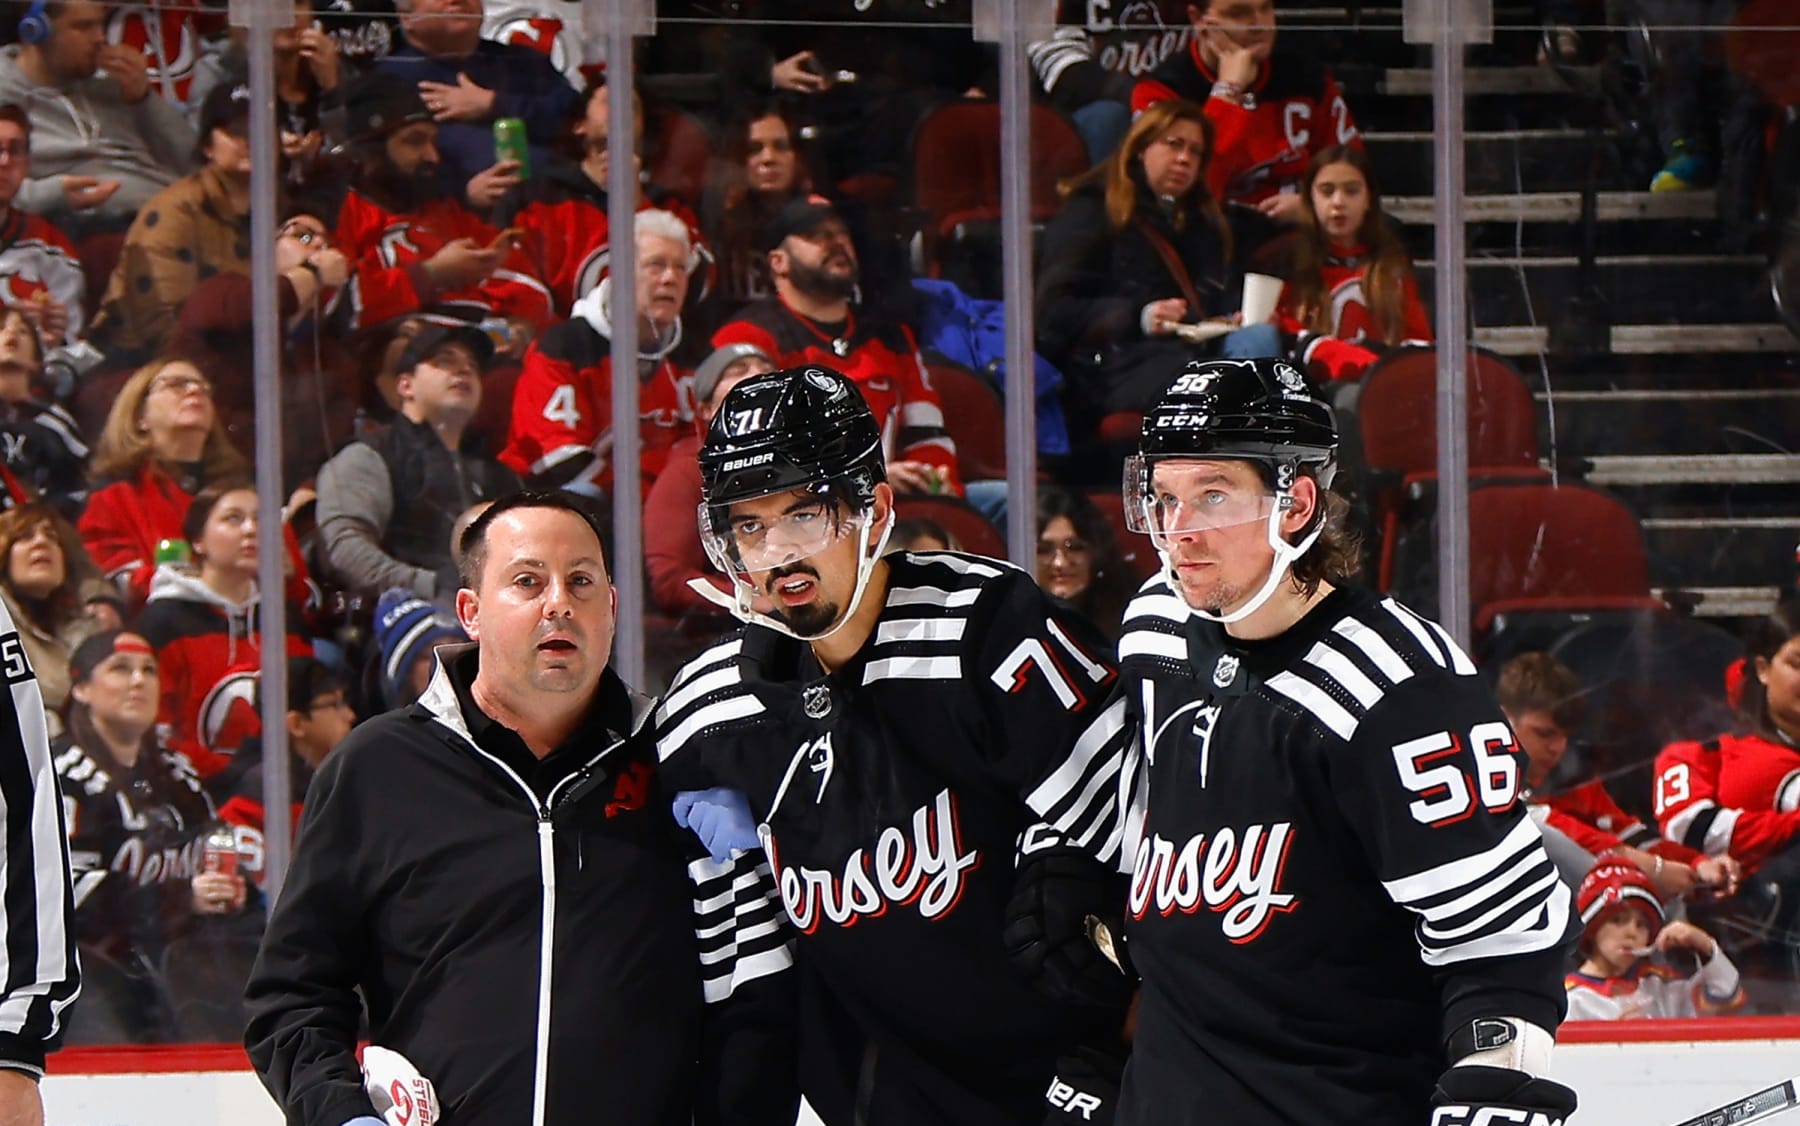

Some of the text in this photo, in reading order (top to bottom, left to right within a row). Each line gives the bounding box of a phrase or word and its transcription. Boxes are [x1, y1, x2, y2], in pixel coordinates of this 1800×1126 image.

[1171, 374, 1216, 392] 56
[735, 408, 763, 436] 71
[1156, 415, 1208, 427] CCM
[990, 617, 1118, 711] 71
[1392, 722, 1520, 828] 56
[1655, 764, 1690, 816] 13
[758, 788, 981, 935] ersey
[1131, 822, 1300, 945] ersey
